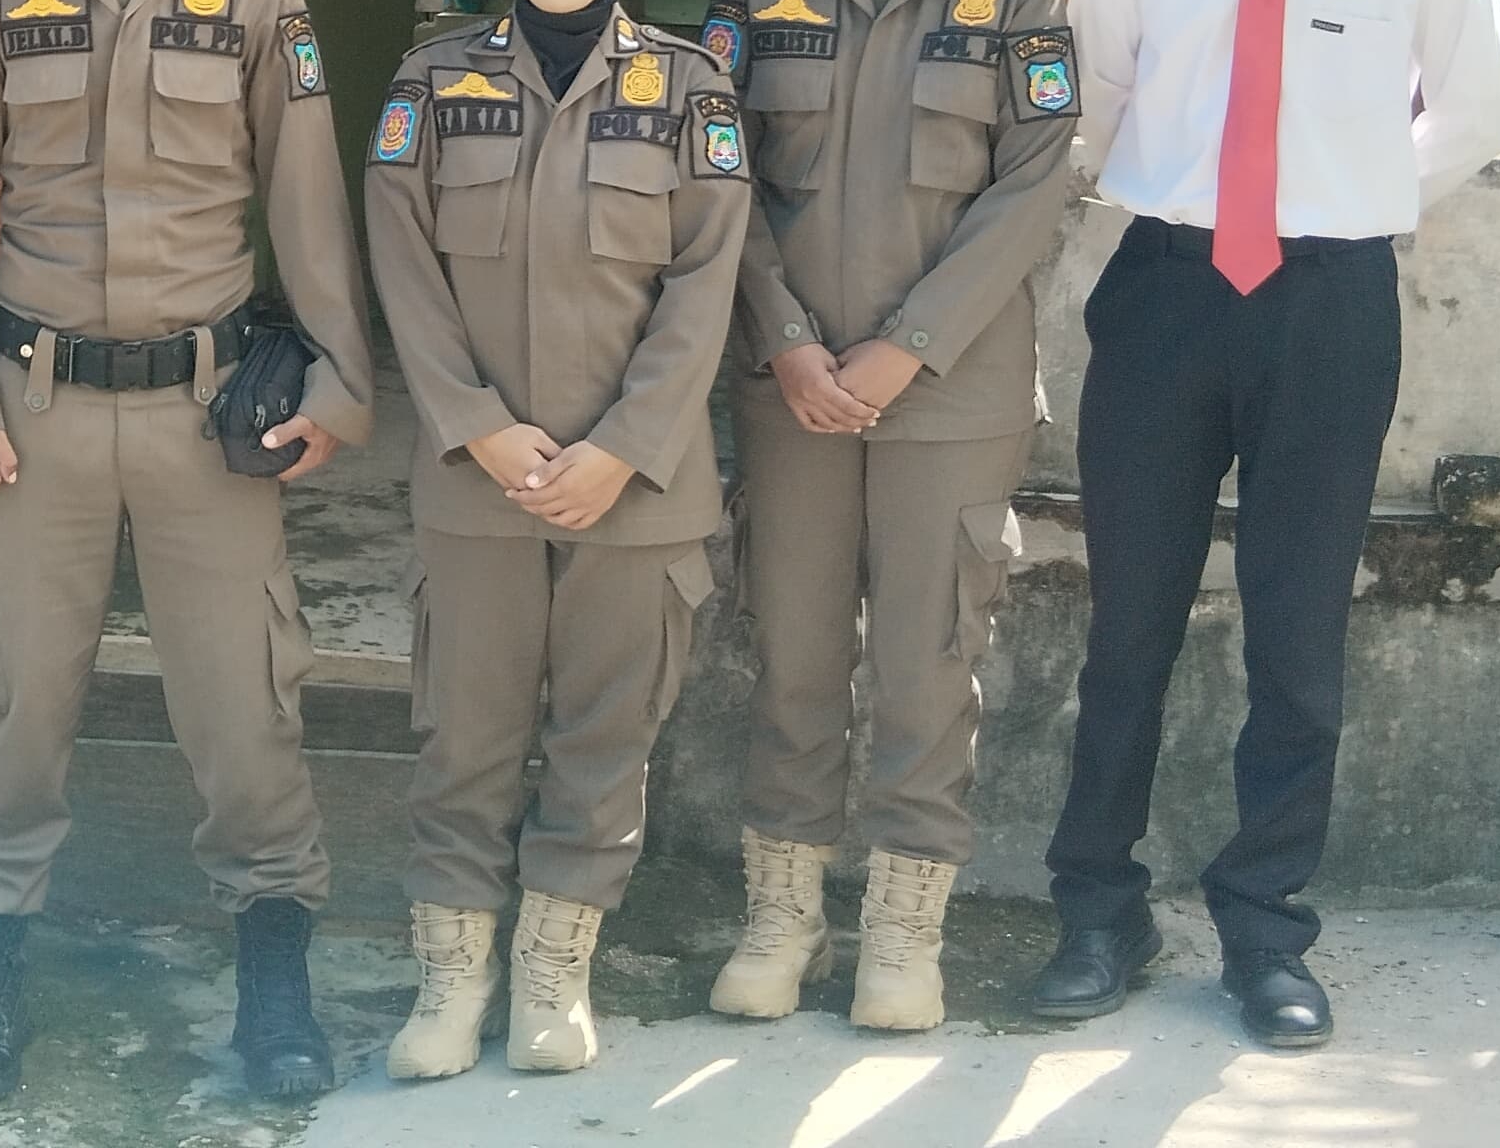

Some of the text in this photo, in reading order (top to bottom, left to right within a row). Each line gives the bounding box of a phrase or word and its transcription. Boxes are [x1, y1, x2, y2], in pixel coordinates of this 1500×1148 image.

[6, 27, 86, 55] JELKI.D
[156, 22, 241, 51] POL PP
[926, 36, 974, 57] POL
[592, 114, 641, 136] POL
